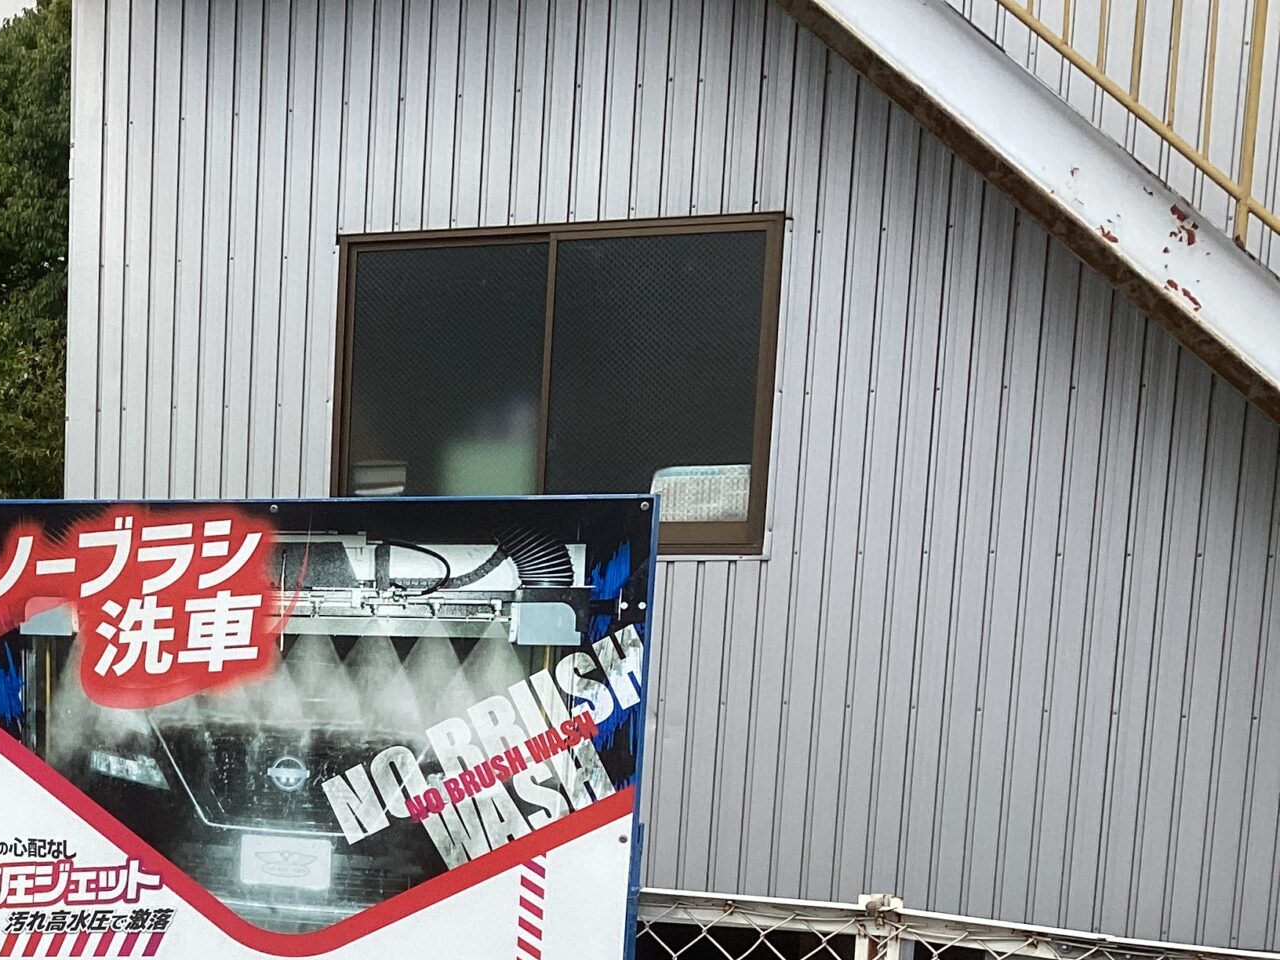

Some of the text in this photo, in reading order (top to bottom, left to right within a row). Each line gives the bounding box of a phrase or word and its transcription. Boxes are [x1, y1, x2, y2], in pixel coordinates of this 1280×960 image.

[94, 590, 263, 677] 洗車
[321, 624, 645, 845] NO BRUSH
[404, 710, 600, 823] NO BRUSH WASH
[420, 738, 617, 870] WASH
[5, 908, 174, 932] 汚れ高水圧で激落
